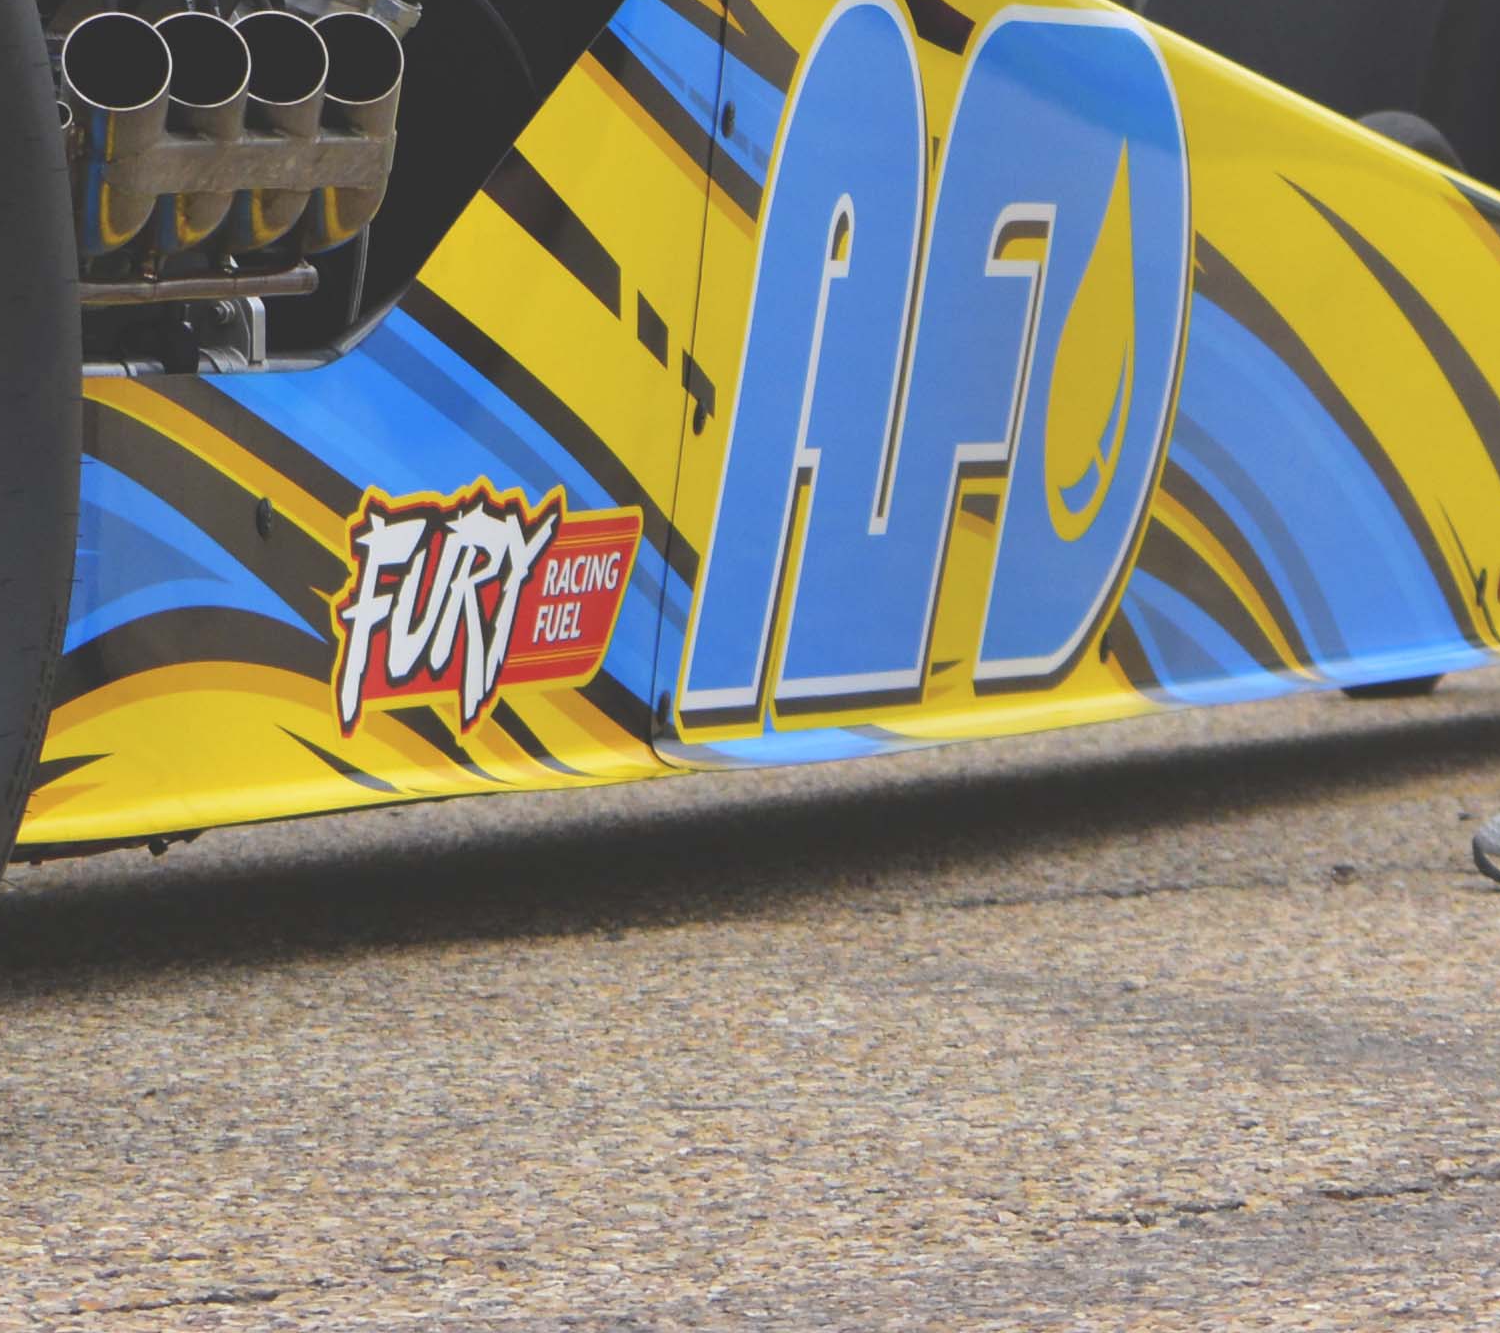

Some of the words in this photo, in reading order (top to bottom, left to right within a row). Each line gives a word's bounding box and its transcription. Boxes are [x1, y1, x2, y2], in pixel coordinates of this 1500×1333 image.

[542, 550, 620, 596] RACING
[340, 495, 561, 728] FURY
[533, 603, 582, 643] FUEL
